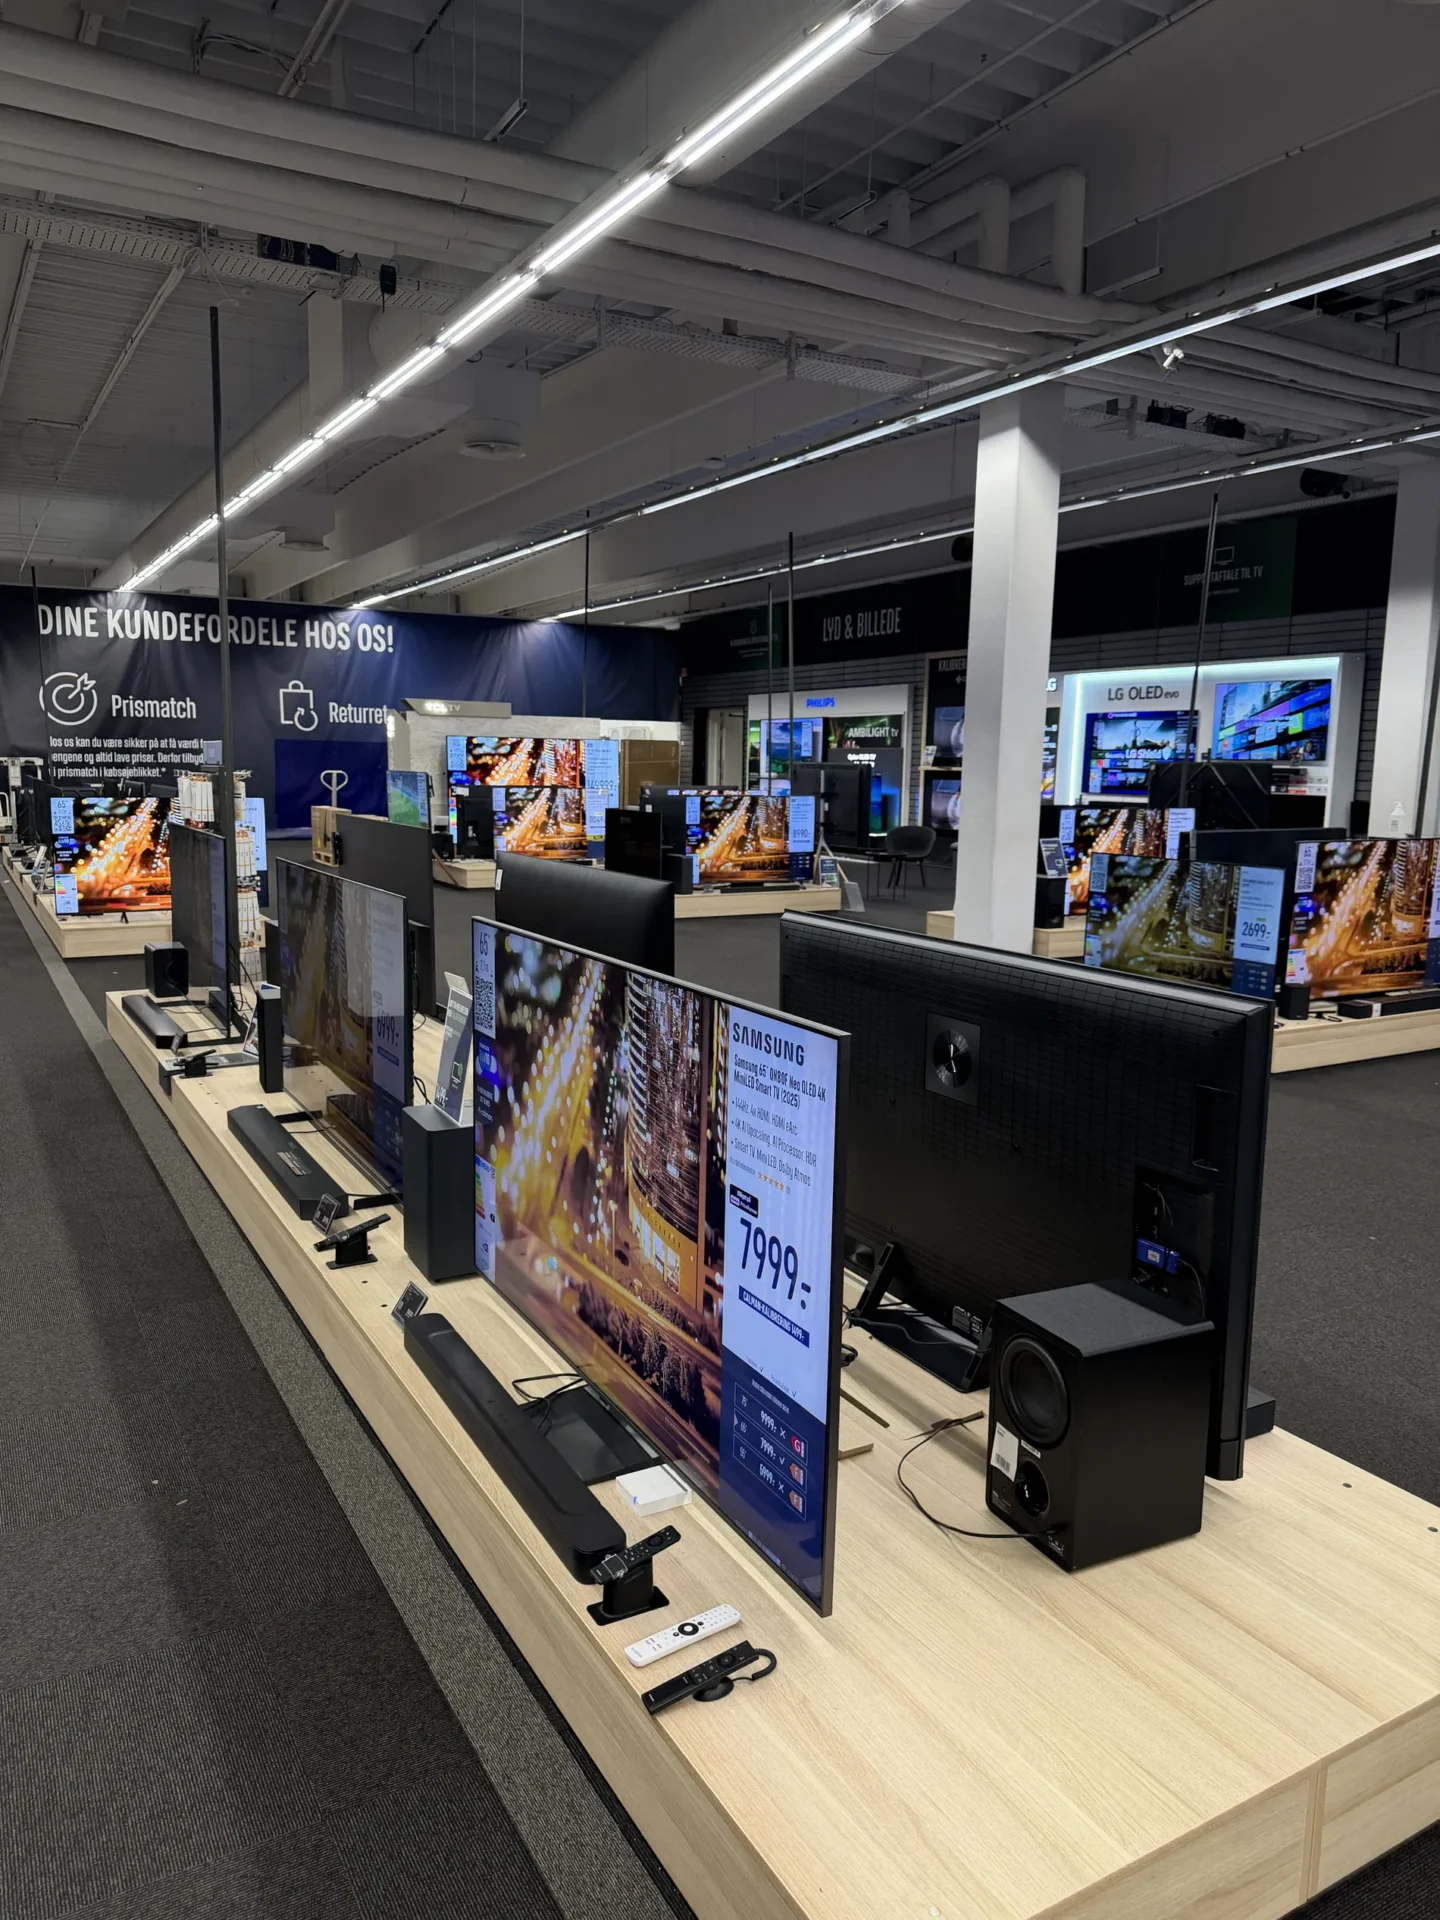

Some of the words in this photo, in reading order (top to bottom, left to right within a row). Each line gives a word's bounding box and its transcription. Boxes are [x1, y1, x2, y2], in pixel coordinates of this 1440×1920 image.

[1183, 568, 1239, 587] SUPPOTAFTALE
[1253, 565, 1264, 578] TV
[38, 604, 99, 637] DINE
[107, 608, 298, 648] KUNDEFORDELE
[305, 621, 351, 651] HOS
[357, 623, 394, 653] OS!
[822, 615, 841, 643] LYD
[844, 615, 853, 640] &
[857, 606, 902, 639] BILLEDE
[1046, 677, 1057, 692] G
[1108, 688, 1124, 701] LG
[1128, 685, 1164, 700] OLED
[1164, 690, 1180, 699] evo
[111, 695, 197, 719] Prismatch
[425, 702, 448, 713] TCL
[448, 704, 460, 712] TV
[806, 697, 836, 708] PHILIPS
[329, 702, 388, 724] Returret
[848, 727, 890, 738] AMBILIGHT
[64, 738, 74, 748] os
[76, 736, 91, 748] kan
[92, 736, 102, 748] du
[103, 739, 123, 748] være
[124, 737, 148, 749] sikker
[149, 738, 159, 750] på
[160, 739, 169, 749] at
[169, 738, 177, 749] få
[178, 738, 199, 749] værdi
[51, 752, 83, 765] engene
[84, 753, 94, 765] og
[95, 751, 113, 763] altid
[114, 752, 130, 763] lave
[131, 752, 156, 765] priser.
[158, 752, 181, 763] Derfor
[182, 753, 204, 766] tilbyd
[57, 766, 99, 780] prismatch
[732, 1022, 805, 1066] SAMSUNG
[734, 1053, 758, 1077] Samsung
[789, 1074, 801, 1092] Neo
[801, 1079, 817, 1098] QLED
[818, 1085, 826, 1103] 4K
[733, 1069, 754, 1090] MiniLED
[755, 1078, 772, 1097] Smart
[773, 1085, 780, 1100] TV
[781, 1087, 801, 1111] (2025)
[734, 1137, 749, 1155] Smart
[779, 1159, 794, 1180] Dolby
[794, 1167, 811, 1187] Atmos
[794, 1439, 801, 1452] G
